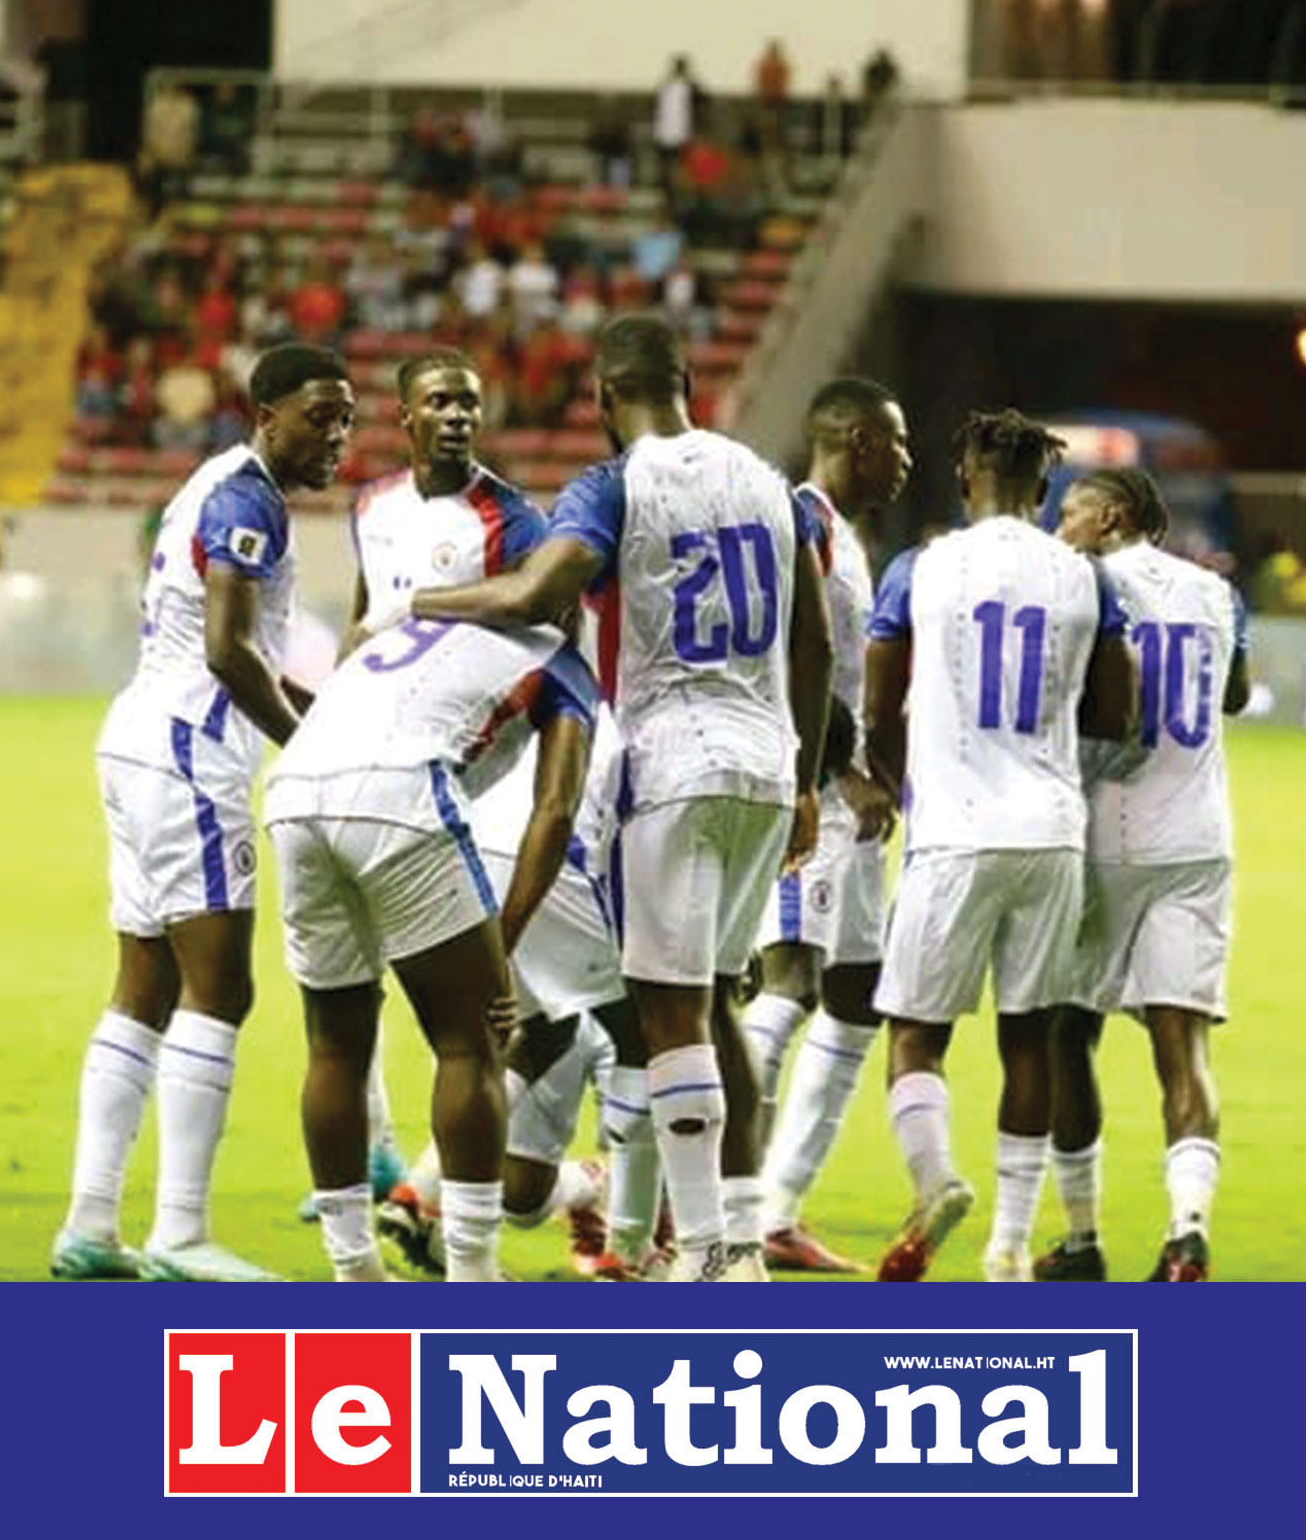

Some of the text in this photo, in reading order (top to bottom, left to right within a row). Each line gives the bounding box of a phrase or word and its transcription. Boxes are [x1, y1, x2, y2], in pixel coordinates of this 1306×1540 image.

[671, 523, 778, 663] 20
[972, 600, 1046, 734] 11
[1131, 622, 1212, 749] 10
